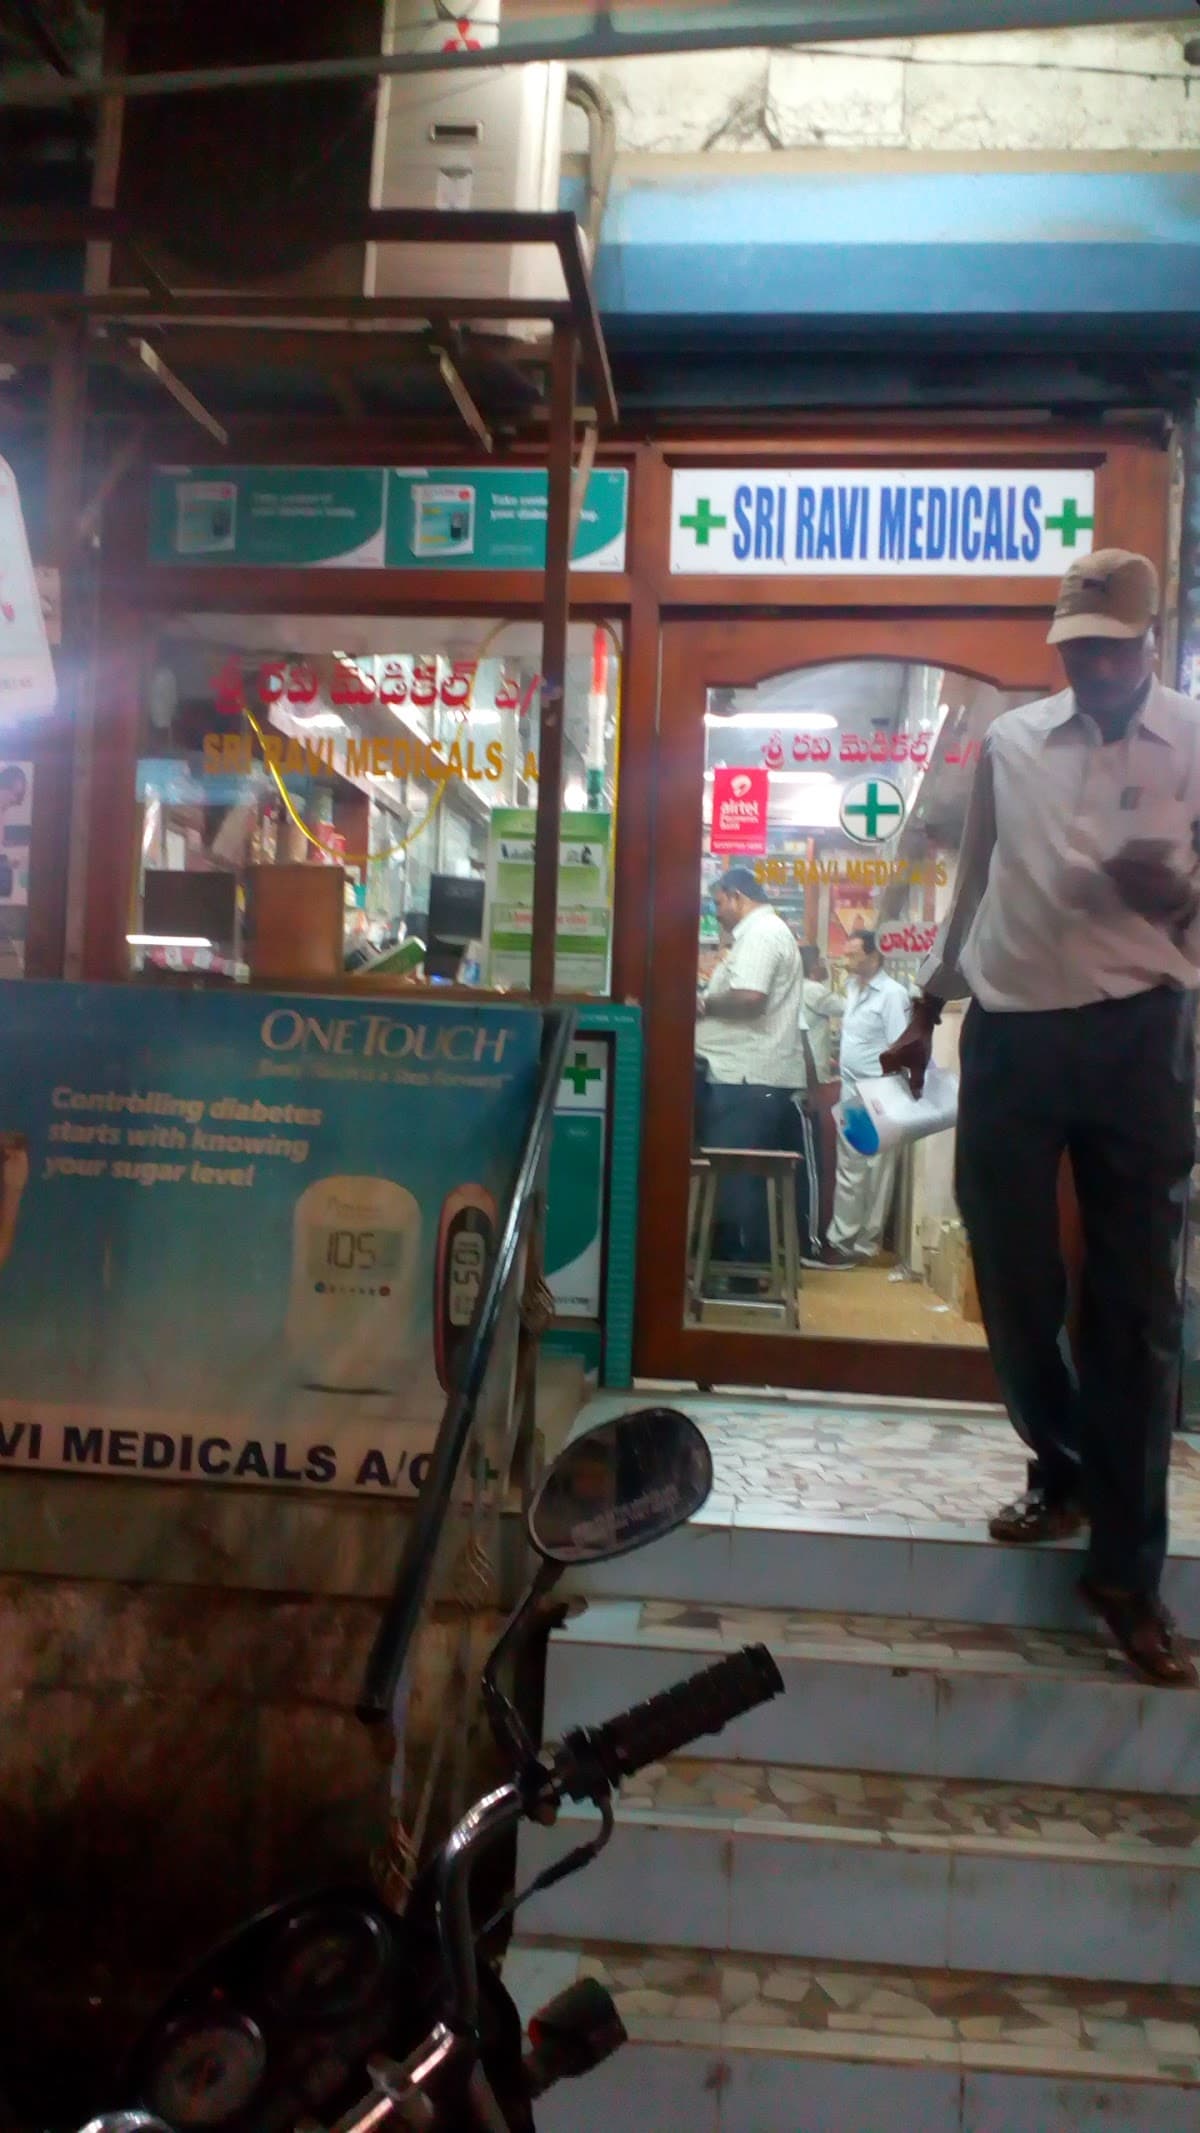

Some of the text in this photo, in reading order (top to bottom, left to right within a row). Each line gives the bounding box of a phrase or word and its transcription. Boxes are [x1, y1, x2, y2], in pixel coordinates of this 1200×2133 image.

[732, 485, 1042, 562] SRI RAVI MEDICALS
[203, 733, 250, 775] SRI
[263, 734, 335, 779] RAVI
[353, 737, 504, 782] MEDICALS
[754, 859, 948, 888] SRI RAVI MEDICAS
[52, 1086, 205, 1123] Controlling
[49, 1120, 311, 1163] starts with knowing
[42, 1156, 256, 1187] your sugar level
[62, 1425, 337, 1483] MEDICALS
